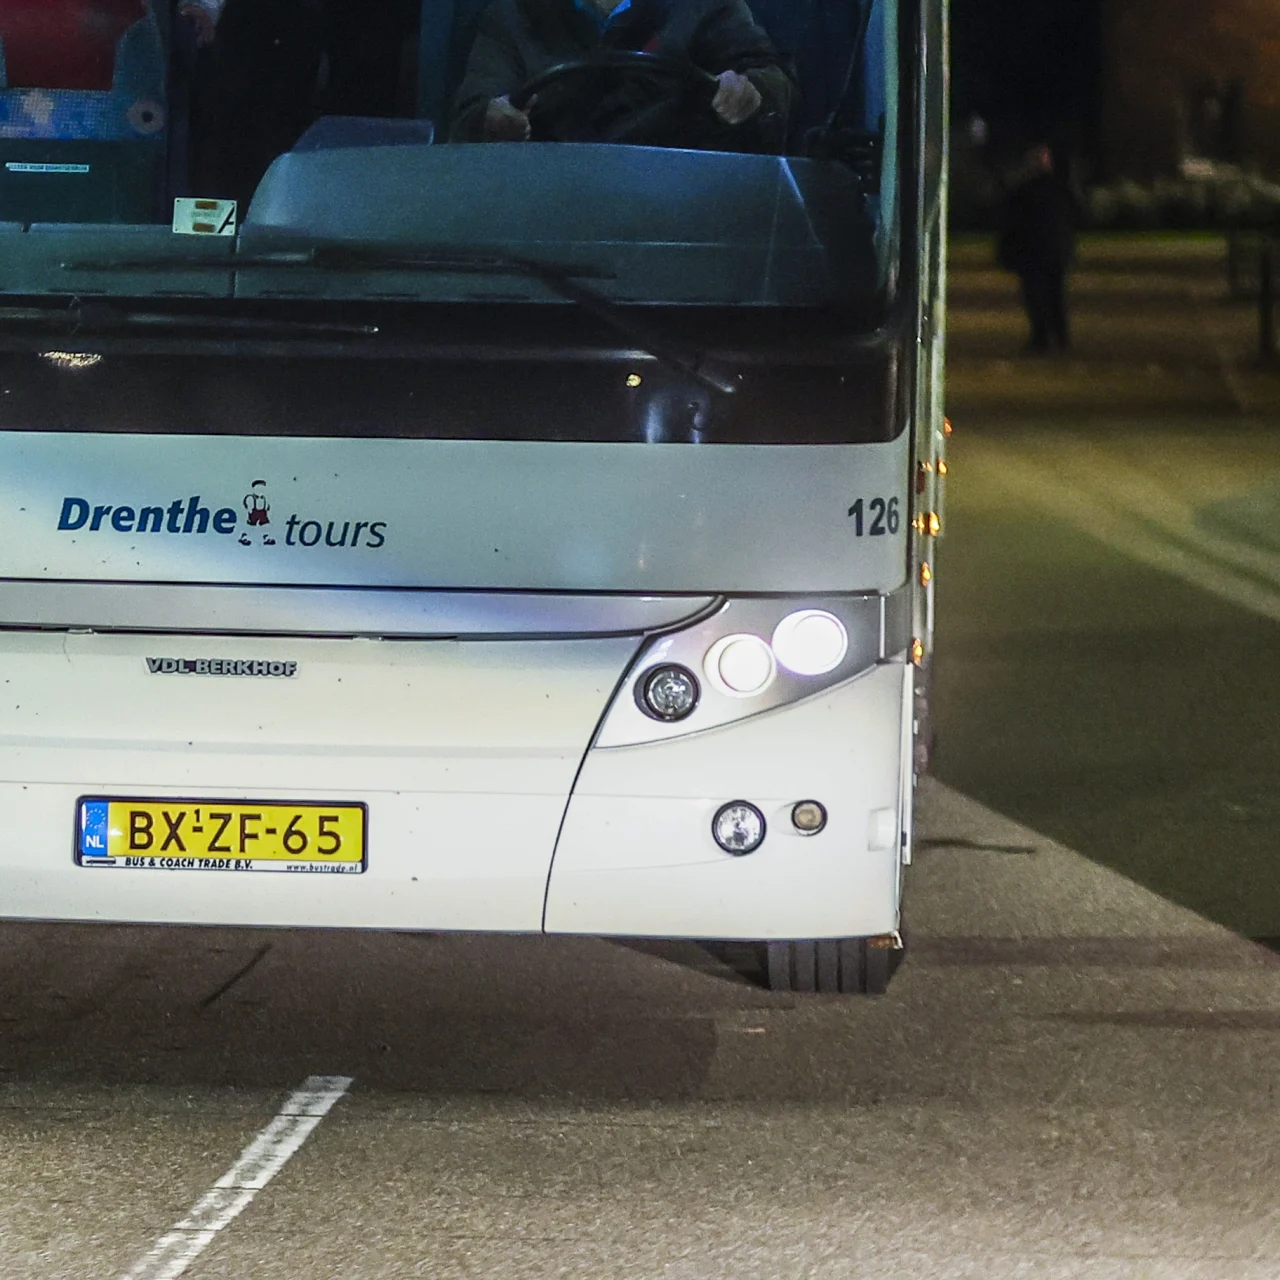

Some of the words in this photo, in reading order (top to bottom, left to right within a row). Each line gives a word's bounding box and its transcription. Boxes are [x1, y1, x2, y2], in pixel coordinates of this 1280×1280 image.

[57, 496, 237, 534] Drenthe
[285, 514, 387, 548] tours
[848, 496, 899, 536] 126
[146, 657, 189, 673] VDL
[195, 658, 297, 676] BERKHOF
[85, 834, 105, 848] NL
[125, 857, 145, 866] BUS
[148, 857, 156, 867] &
[160, 857, 194, 868] COACH
[198, 858, 230, 869] TRADE
